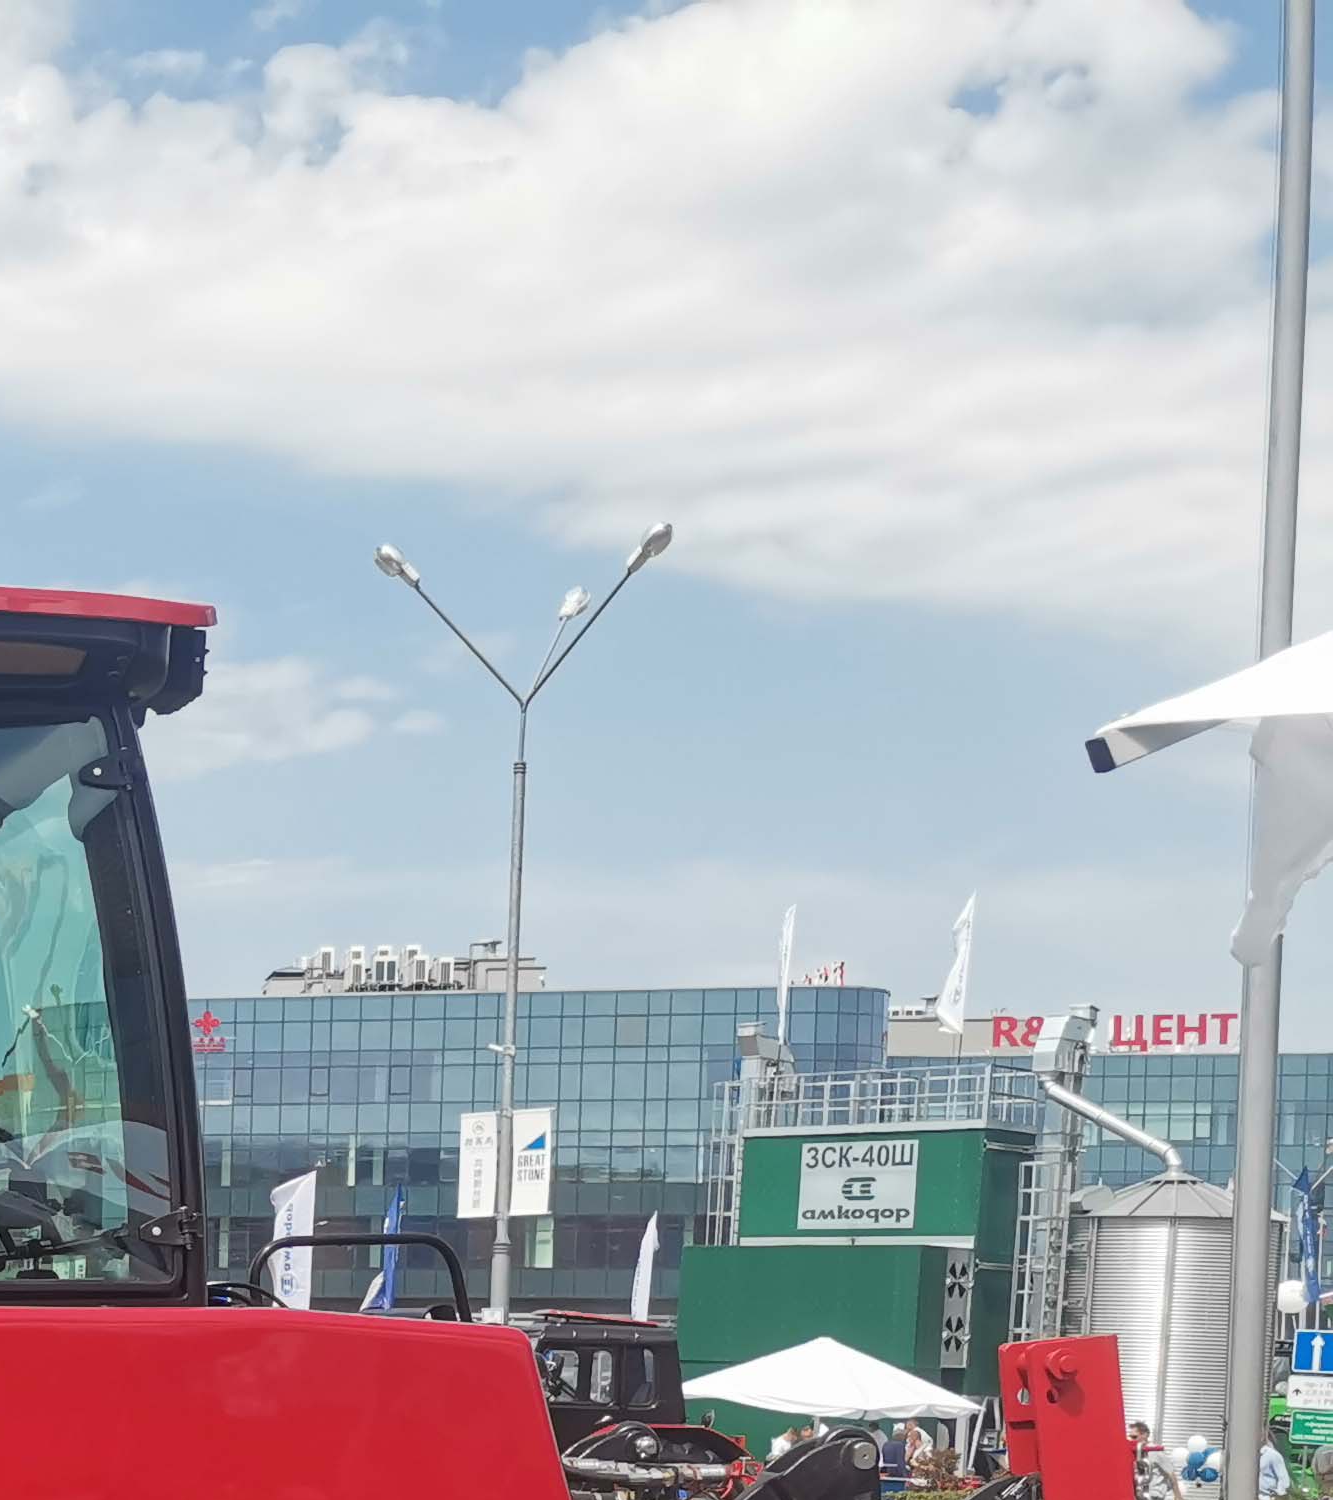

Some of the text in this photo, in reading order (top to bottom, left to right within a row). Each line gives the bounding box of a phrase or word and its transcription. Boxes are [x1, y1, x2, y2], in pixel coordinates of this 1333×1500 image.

[1112, 1013, 1238, 1052] ЦЕНТ
[517, 1154, 546, 1167] GREAT
[805, 1144, 914, 1169] ЗСК-40Ш
[516, 1169, 546, 1182] STONE
